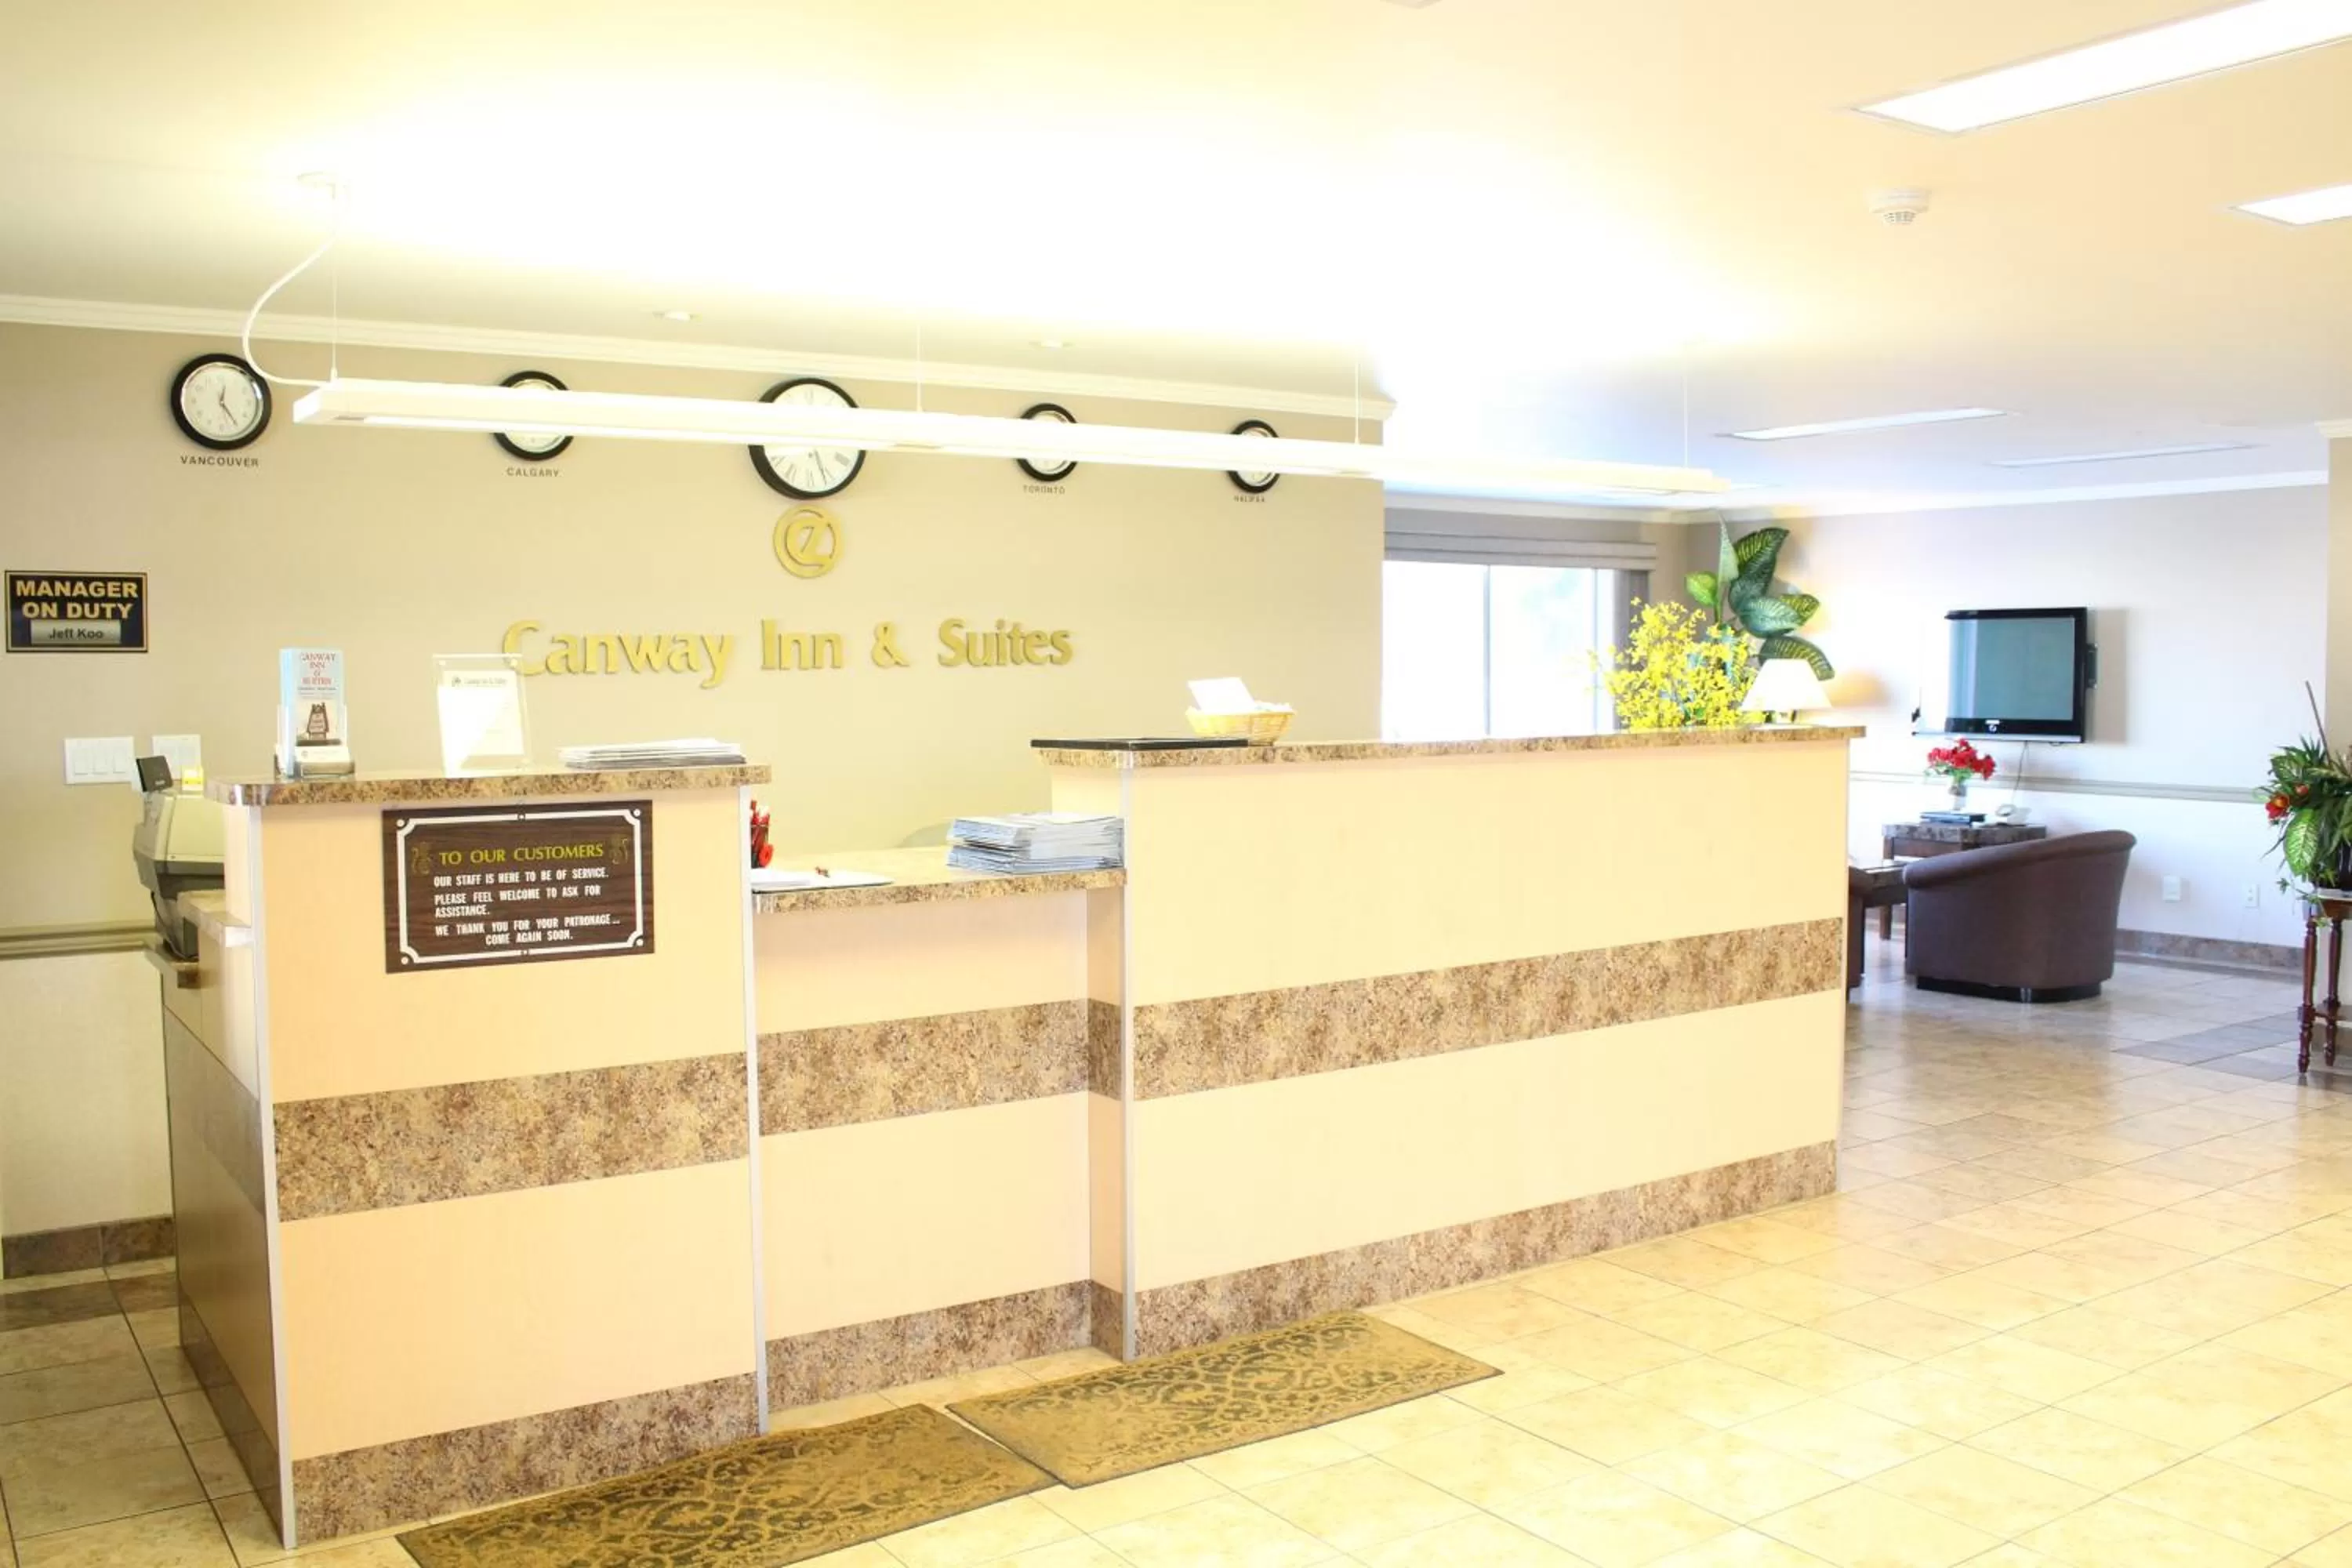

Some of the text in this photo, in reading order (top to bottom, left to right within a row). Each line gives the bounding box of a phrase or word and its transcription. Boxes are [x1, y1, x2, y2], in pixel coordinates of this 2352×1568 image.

[180, 455, 259, 467] VANCOUVER
[506, 467, 559, 477] CALGARY
[1023, 485, 1065, 495] TORONTO
[16, 579, 139, 598] MANAGER
[22, 601, 133, 619] ON DUTY
[502, 618, 1074, 689] Canway Inn & Suites
[439, 844, 604, 866] TO OUR CUSTOMERS
[434, 876, 452, 887] OUR
[456, 874, 482, 886] STAFF
[485, 873, 495, 884] IS
[498, 872, 520, 884] HERE
[524, 871, 536, 882] TO
[540, 869, 553, 881] BE
[556, 869, 568, 880] OF
[434, 885, 601, 906] PLEASE FEEL WELCOME TO ASK FOR
[434, 905, 490, 918] ASSISTANCE.
[434, 925, 449, 937] WE
[456, 923, 485, 935] THANK
[492, 922, 509, 932] YOU
[514, 920, 531, 931] FOR
[535, 918, 559, 929] YOUR
[485, 928, 574, 946] COME AGAIN SOON.
